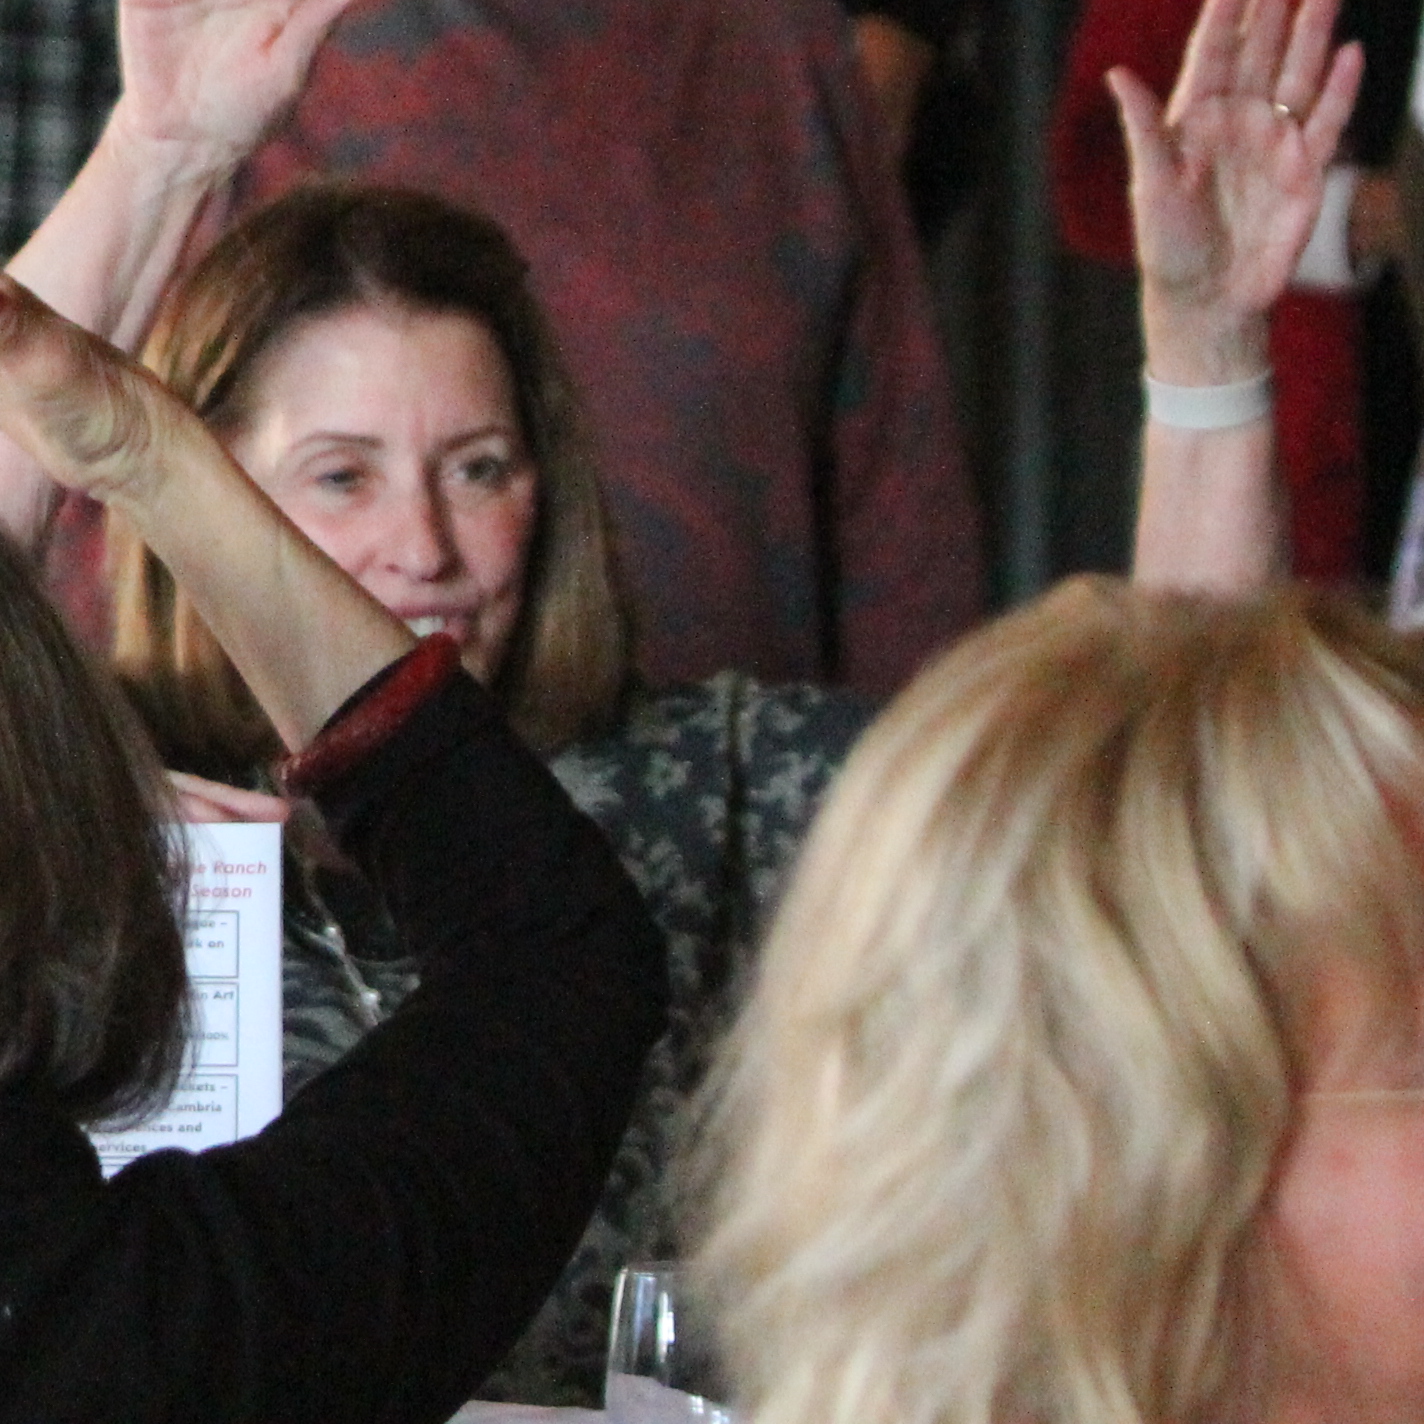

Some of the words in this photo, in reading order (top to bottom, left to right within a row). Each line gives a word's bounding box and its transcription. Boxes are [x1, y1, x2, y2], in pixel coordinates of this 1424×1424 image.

[213, 860, 268, 874] Ranch
[191, 884, 252, 898] Season
[213, 990, 235, 1000] Art
[177, 1122, 203, 1133] and
